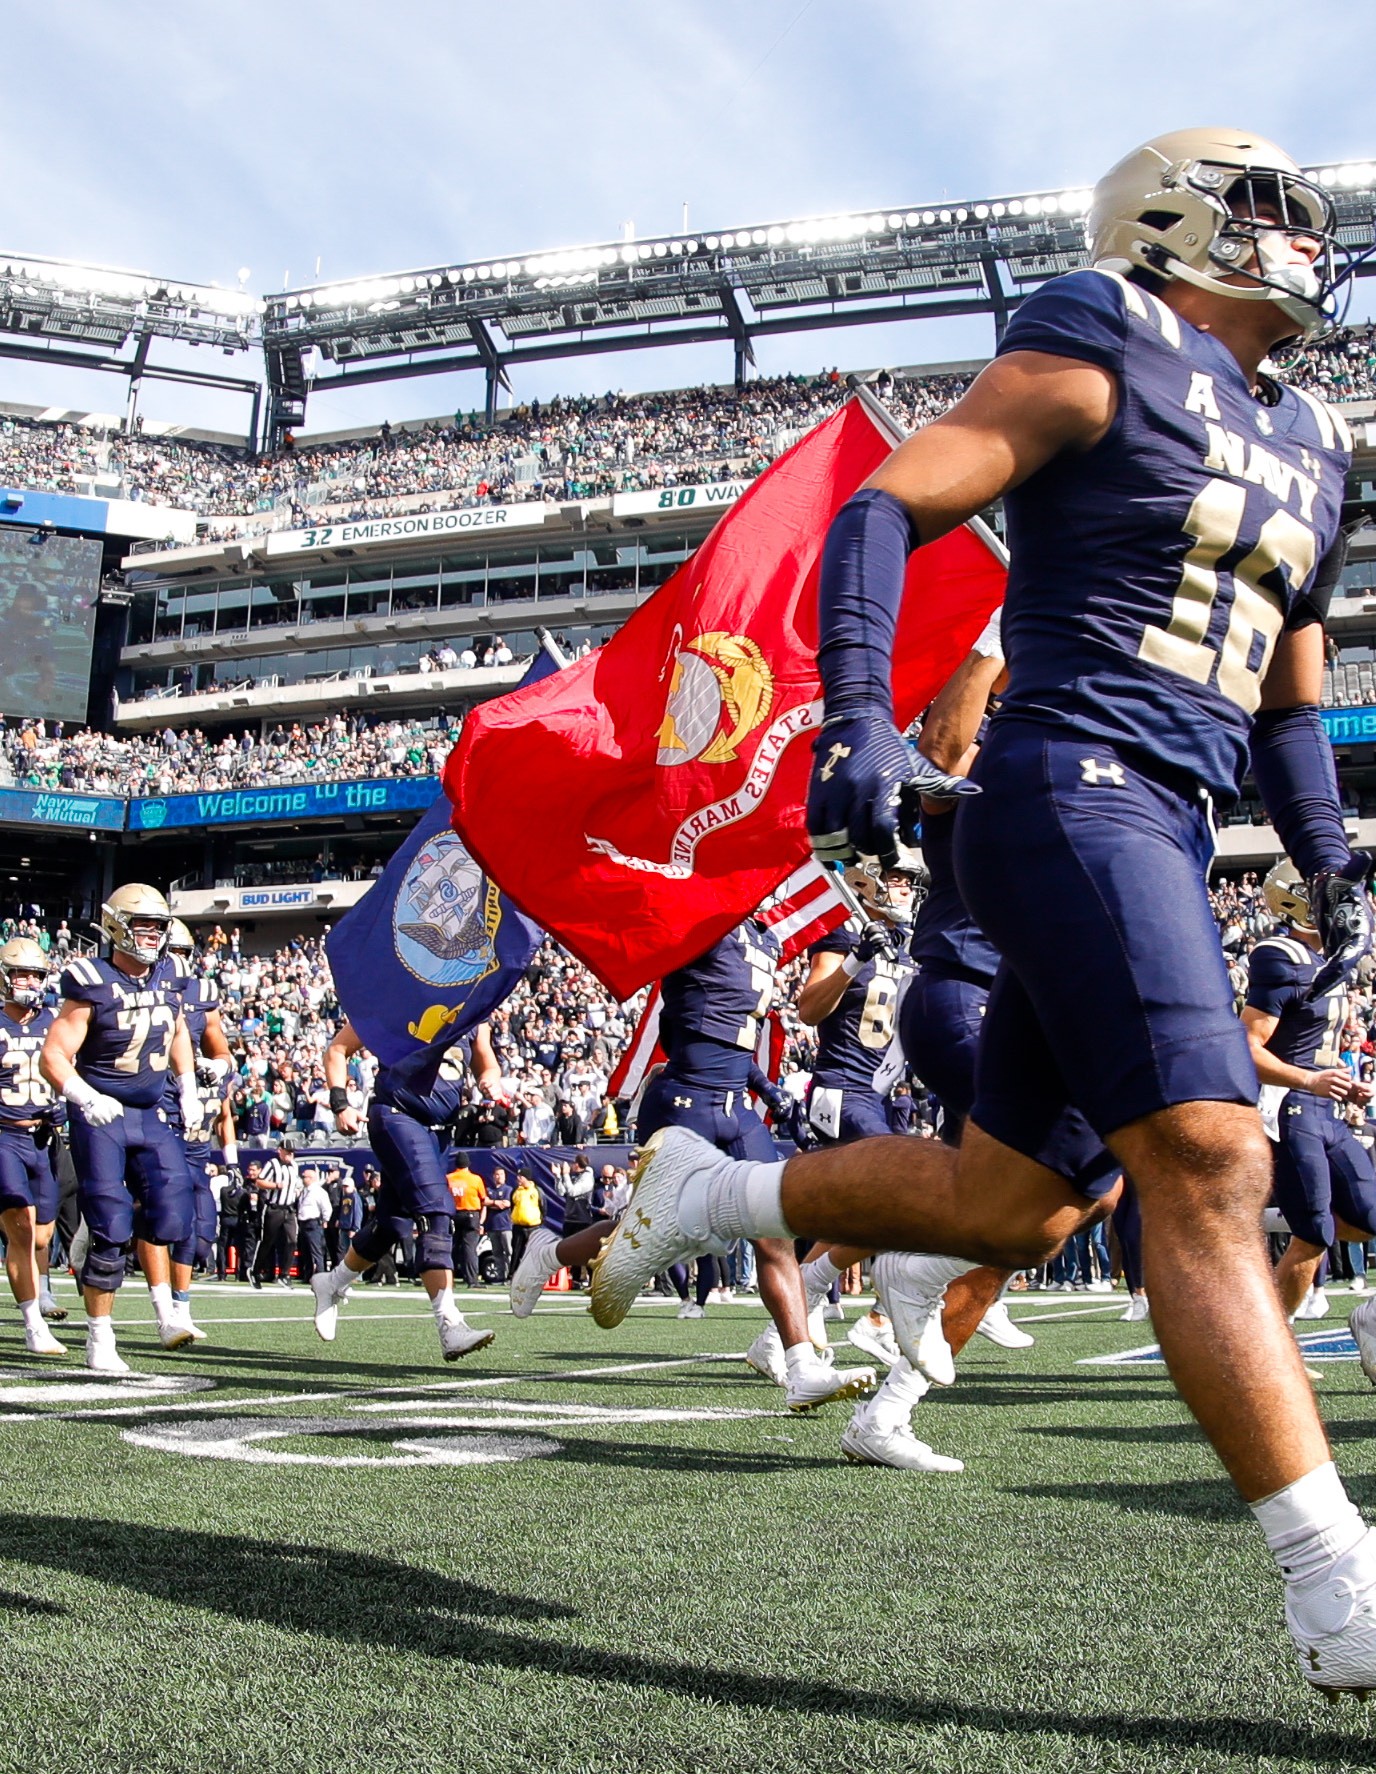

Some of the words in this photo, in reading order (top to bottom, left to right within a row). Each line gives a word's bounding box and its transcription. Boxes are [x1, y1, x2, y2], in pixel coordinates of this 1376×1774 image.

[1184, 370, 1221, 420] A
[1203, 421, 1319, 523] NAVY
[657, 487, 697, 508] 80
[300, 529, 333, 548] 32
[341, 518, 429, 542] EMERSON
[432, 509, 508, 531] BOOZER
[1136, 477, 1318, 716] 16
[36, 794, 74, 811] Navy
[45, 807, 97, 824] Mutual
[198, 792, 307, 818] Welcome
[345, 783, 388, 808] the
[242, 893, 270, 906] BUD
[272, 891, 311, 904] LIGHT
[119, 990, 166, 1009] NAVY
[114, 1006, 177, 1074] 73
